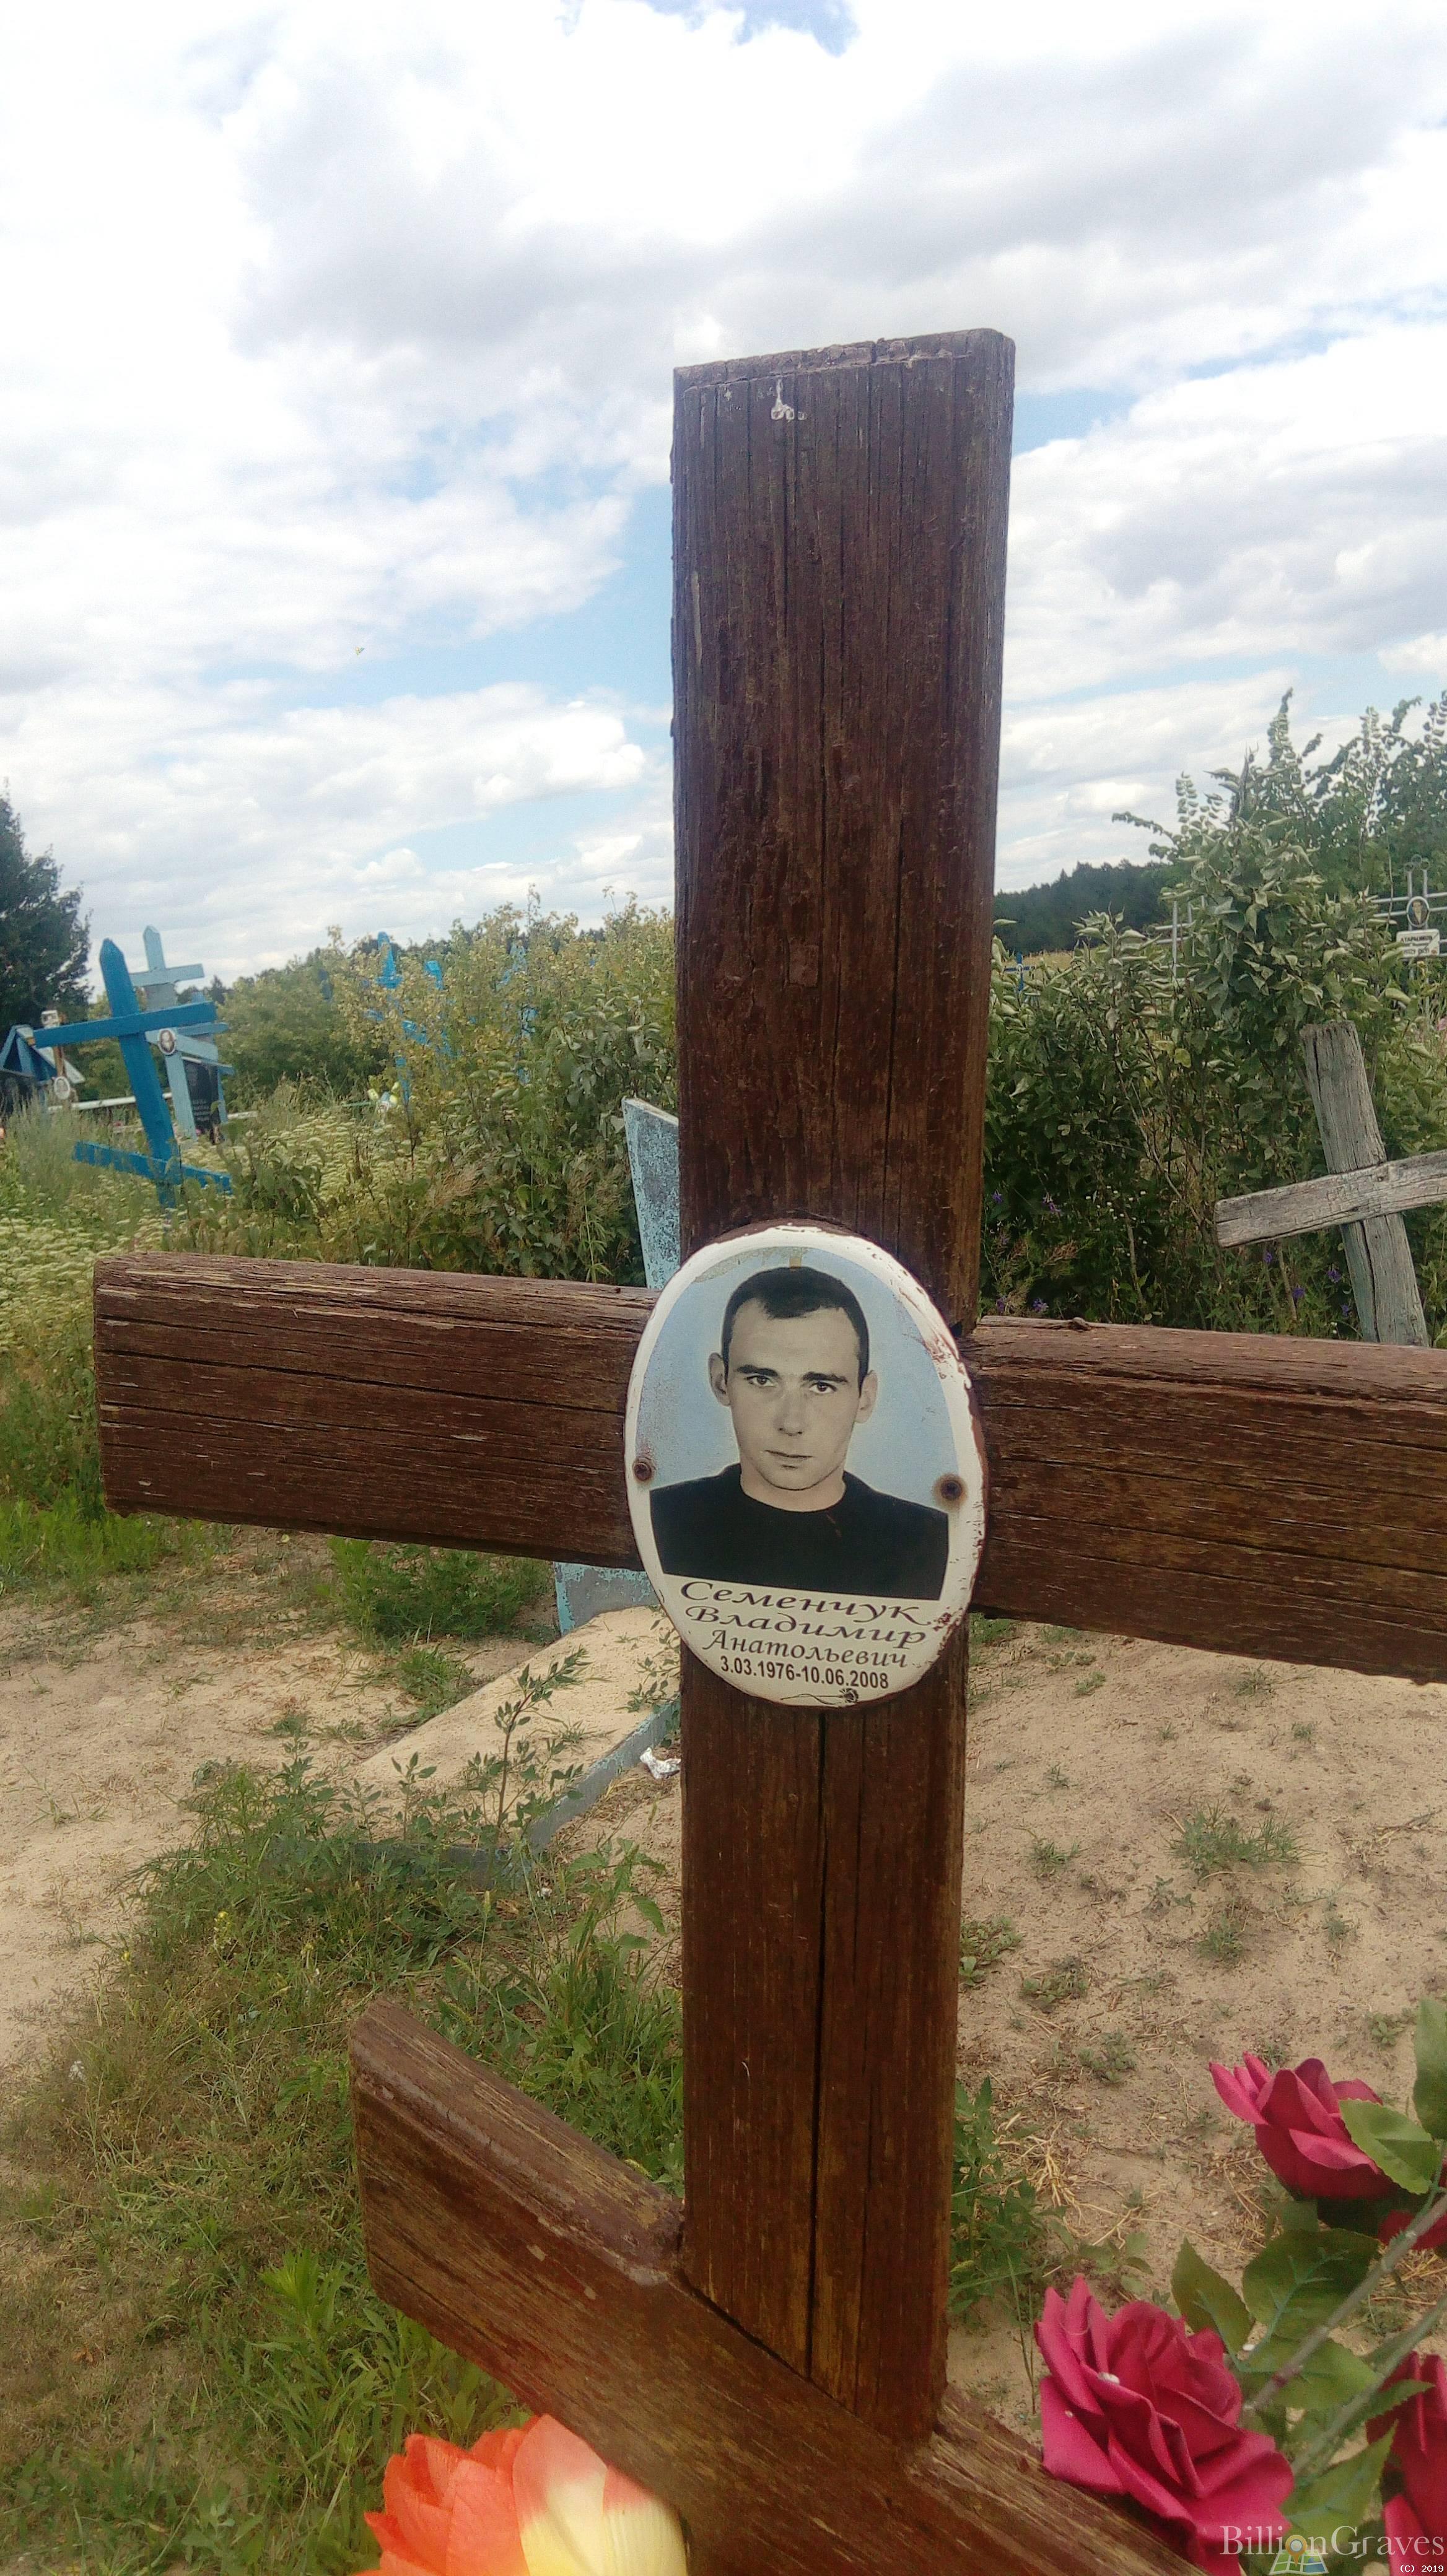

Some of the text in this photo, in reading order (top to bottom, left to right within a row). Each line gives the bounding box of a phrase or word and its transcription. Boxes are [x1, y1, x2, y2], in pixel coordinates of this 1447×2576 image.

[681, 1581, 932, 1626] Семенчук
[685, 1606, 926, 1649] Владимир
[703, 1630, 907, 1668] Анатольевич
[720, 1656, 889, 1689] 3.03.1976-10.06.2008
